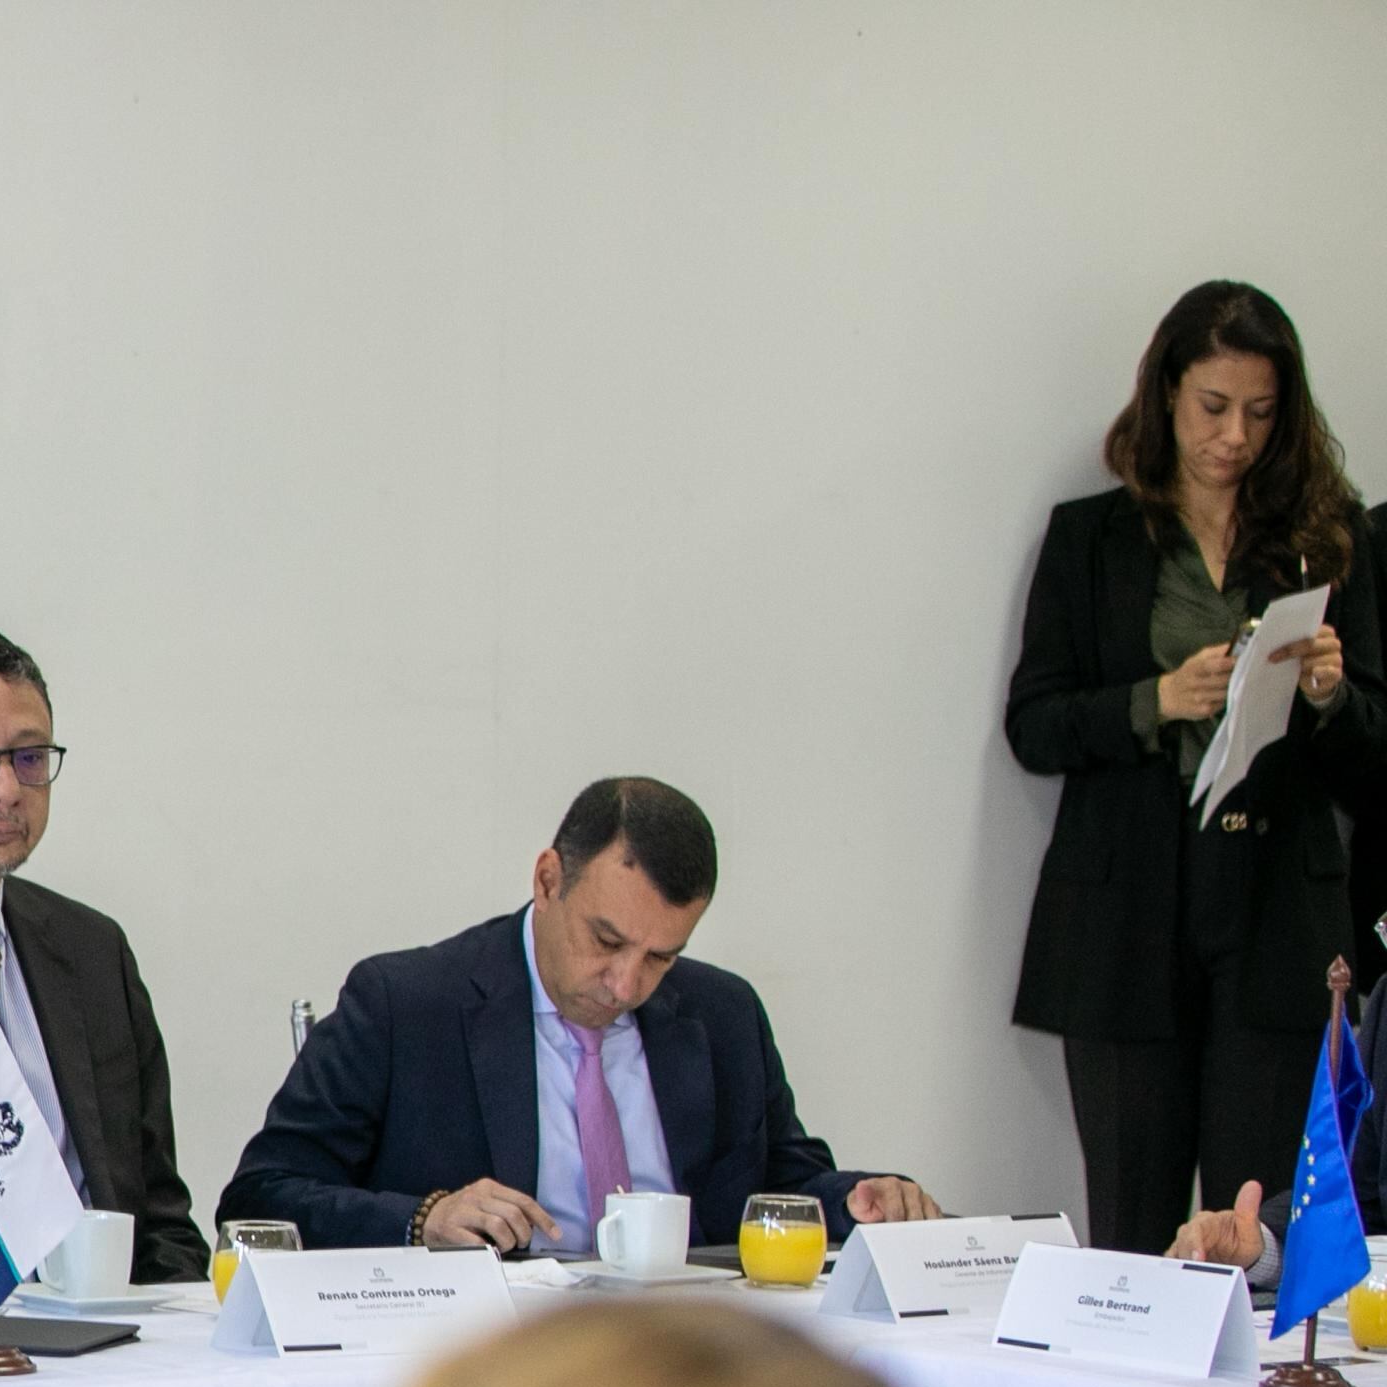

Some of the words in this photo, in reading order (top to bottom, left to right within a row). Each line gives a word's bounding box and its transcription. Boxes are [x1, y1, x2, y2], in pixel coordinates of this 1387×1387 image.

[924, 1258, 972, 1270] Hoslander
[974, 1256, 1002, 1266] Sáenz
[318, 1291, 358, 1301] Renato
[361, 1289, 415, 1300] Contreras
[418, 1287, 456, 1298] Ortega
[1078, 1295, 1104, 1308] Gilles
[1106, 1299, 1151, 1314] Bertrand
